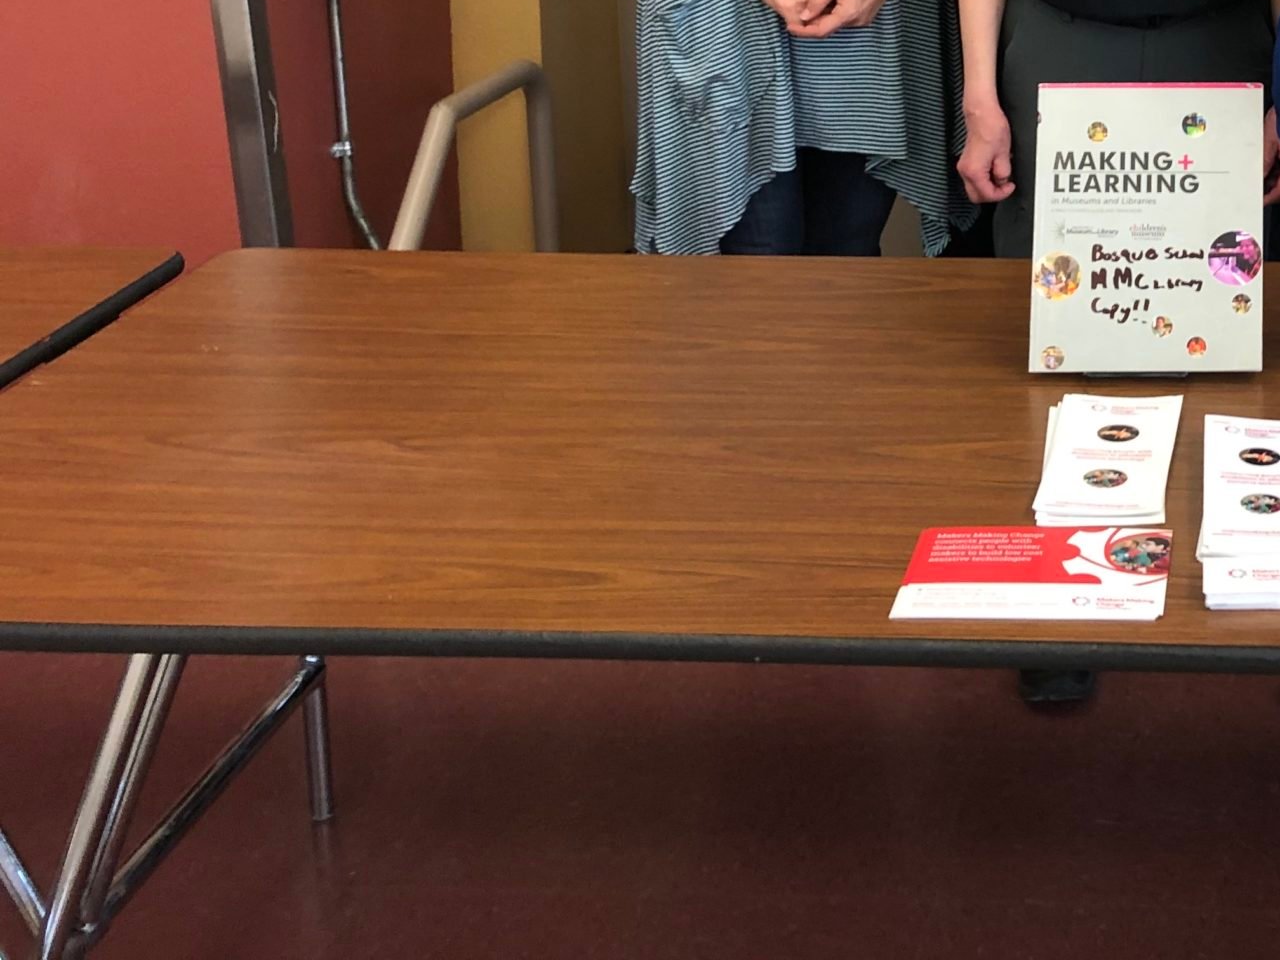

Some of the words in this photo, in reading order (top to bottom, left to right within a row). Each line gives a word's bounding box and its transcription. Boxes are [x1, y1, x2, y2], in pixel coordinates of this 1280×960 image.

[1053, 173, 1200, 194] LEARNING
[1050, 196, 1059, 205] in
[1061, 196, 1101, 205] Museums
[1103, 197, 1119, 205] and
[1121, 196, 1157, 206] Libraries
